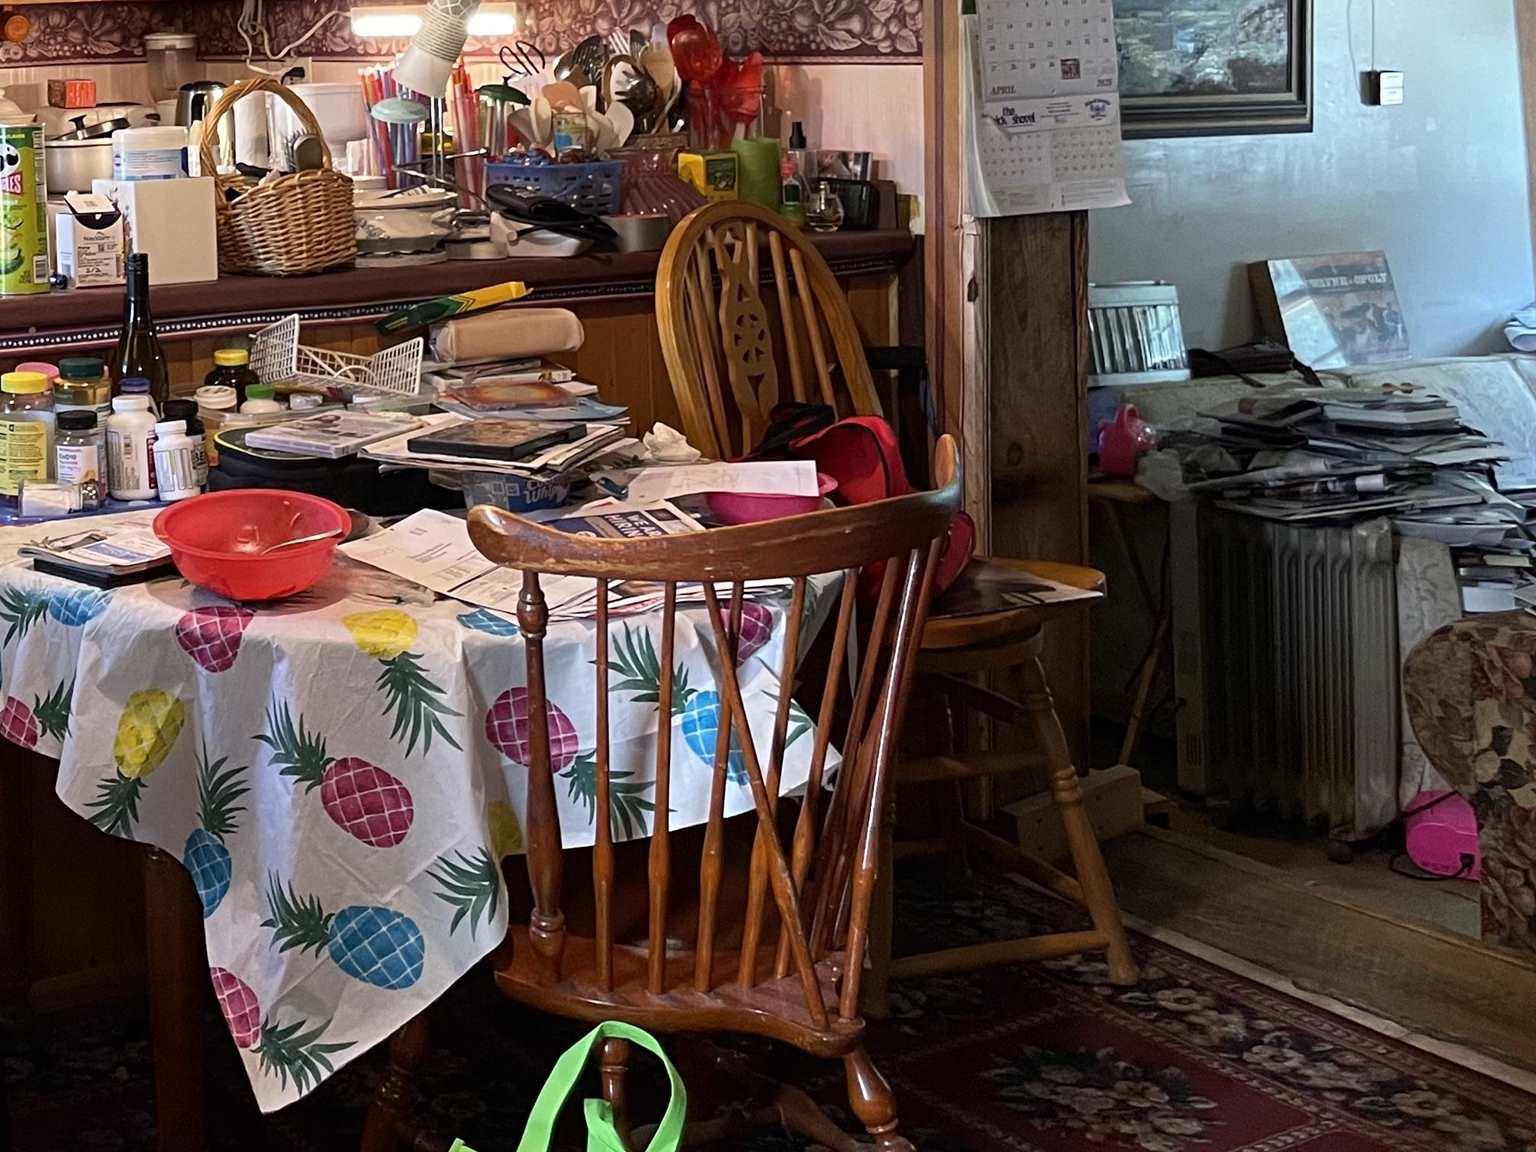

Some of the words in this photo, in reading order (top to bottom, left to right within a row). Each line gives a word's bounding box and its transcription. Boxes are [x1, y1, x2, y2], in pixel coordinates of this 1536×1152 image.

[990, 86, 1016, 95] APRIL
[1002, 106, 1015, 116] the
[604, 515, 644, 538] HIRIN
